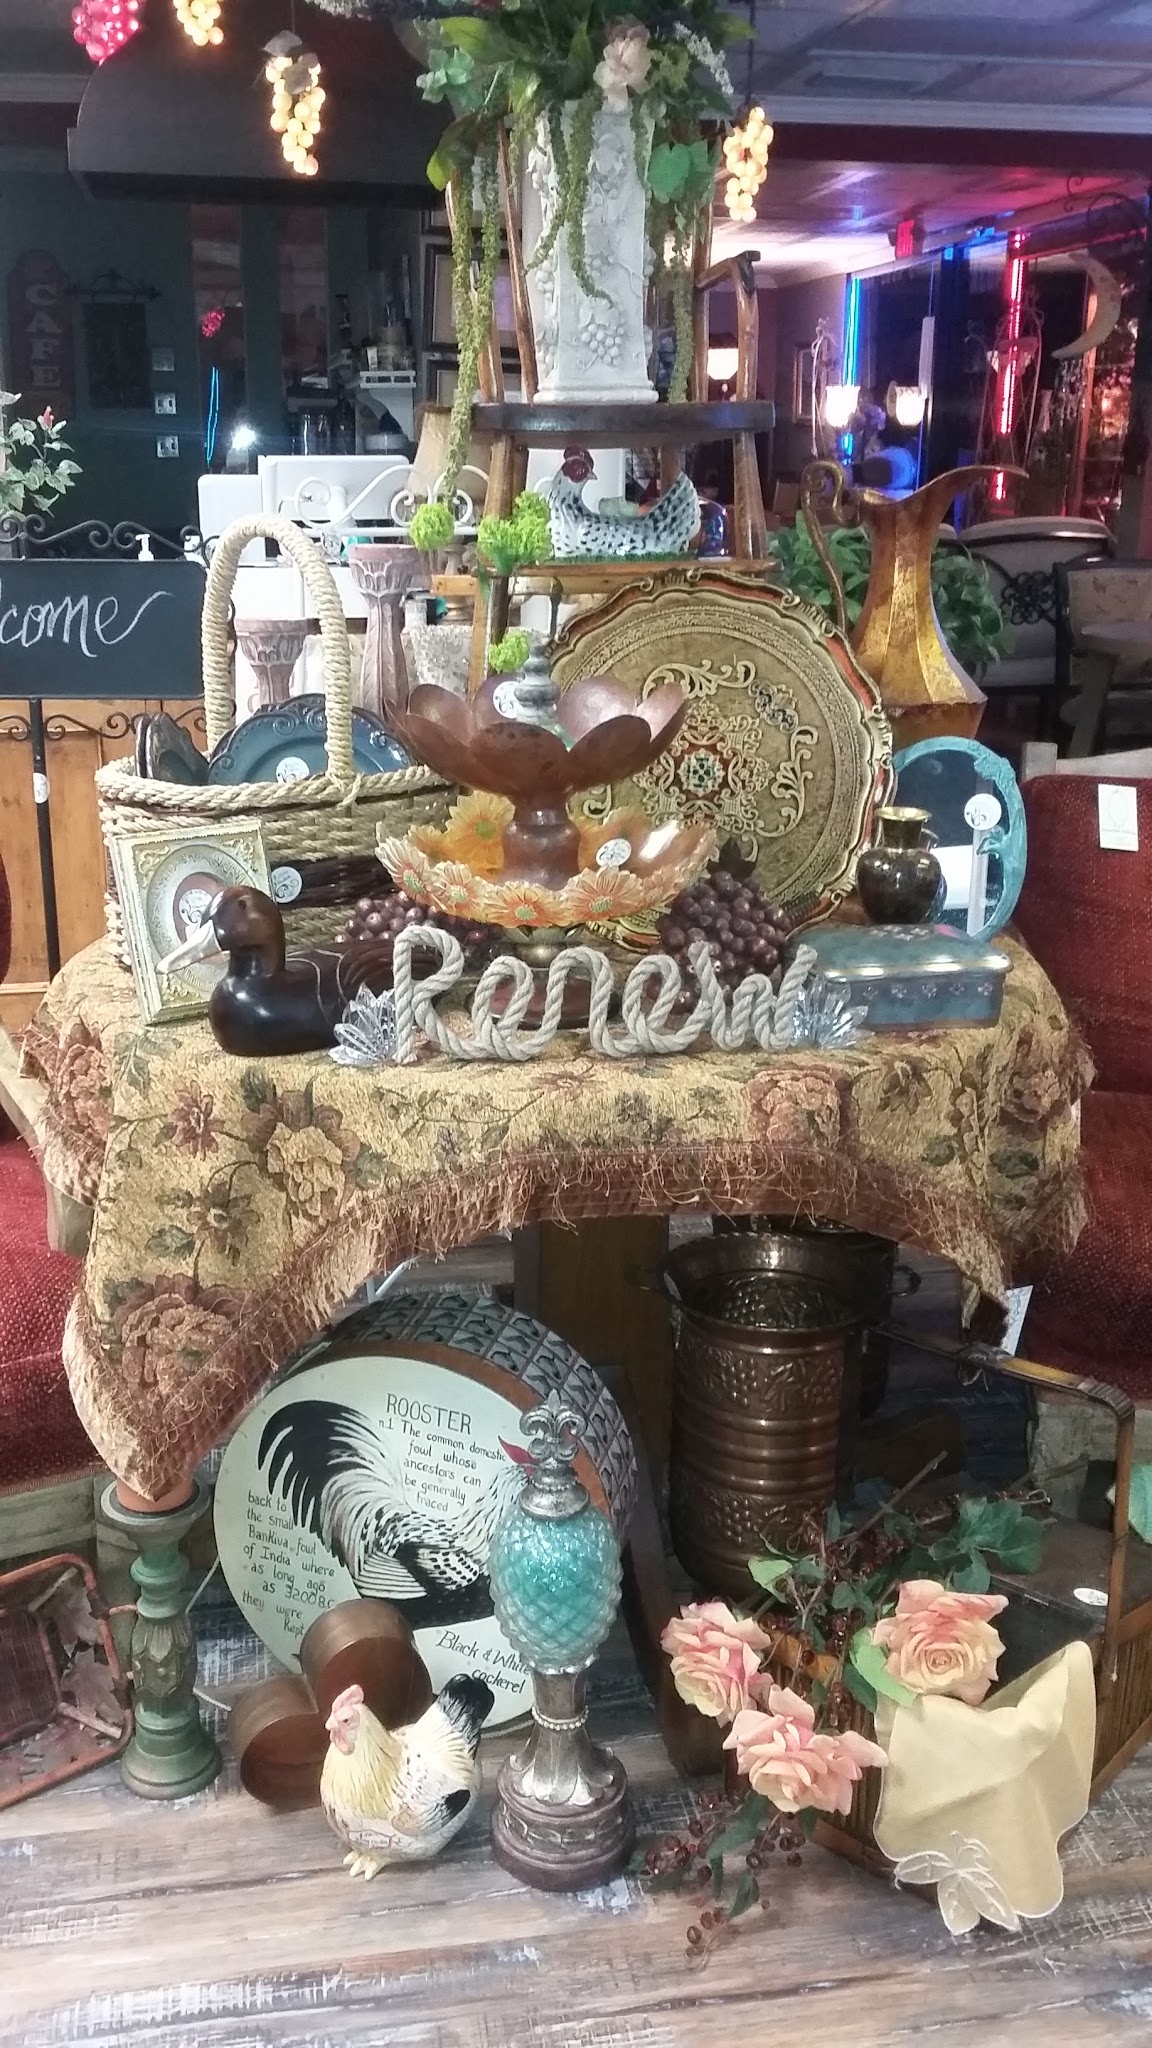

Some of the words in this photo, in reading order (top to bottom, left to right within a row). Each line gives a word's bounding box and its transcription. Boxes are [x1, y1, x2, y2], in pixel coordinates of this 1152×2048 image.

[0, 577, 175, 657] come
[393, 924, 818, 1064] Renew
[386, 1392, 472, 1435] ROOSTER
[401, 1419, 421, 1437] The
[426, 1433, 465, 1450] common
[469, 1441, 506, 1461] domestic
[408, 1439, 432, 1457] fowl
[443, 1450, 477, 1470] whose
[403, 1458, 455, 1480] ancestors
[463, 1475, 482, 1488] can
[248, 1489, 272, 1509] back
[277, 1497, 287, 1512] to
[404, 1472, 417, 1487] be
[421, 1482, 466, 1506] generally
[416, 1491, 449, 1512] traced
[247, 1507, 263, 1523] the
[268, 1515, 294, 1530] small
[243, 1542, 257, 1560] of
[260, 1545, 291, 1566] India
[301, 1558, 335, 1577] where
[296, 1537, 317, 1557] fowl
[251, 1563, 265, 1575] as
[273, 1564, 295, 1588] long
[306, 1580, 326, 1596] ago
[262, 1581, 276, 1594] as
[242, 1589, 265, 1612] they
[276, 1604, 303, 1620] were
[435, 1630, 480, 1659] Black
[492, 1649, 530, 1675] White
[471, 1669, 527, 1694] cockerel
